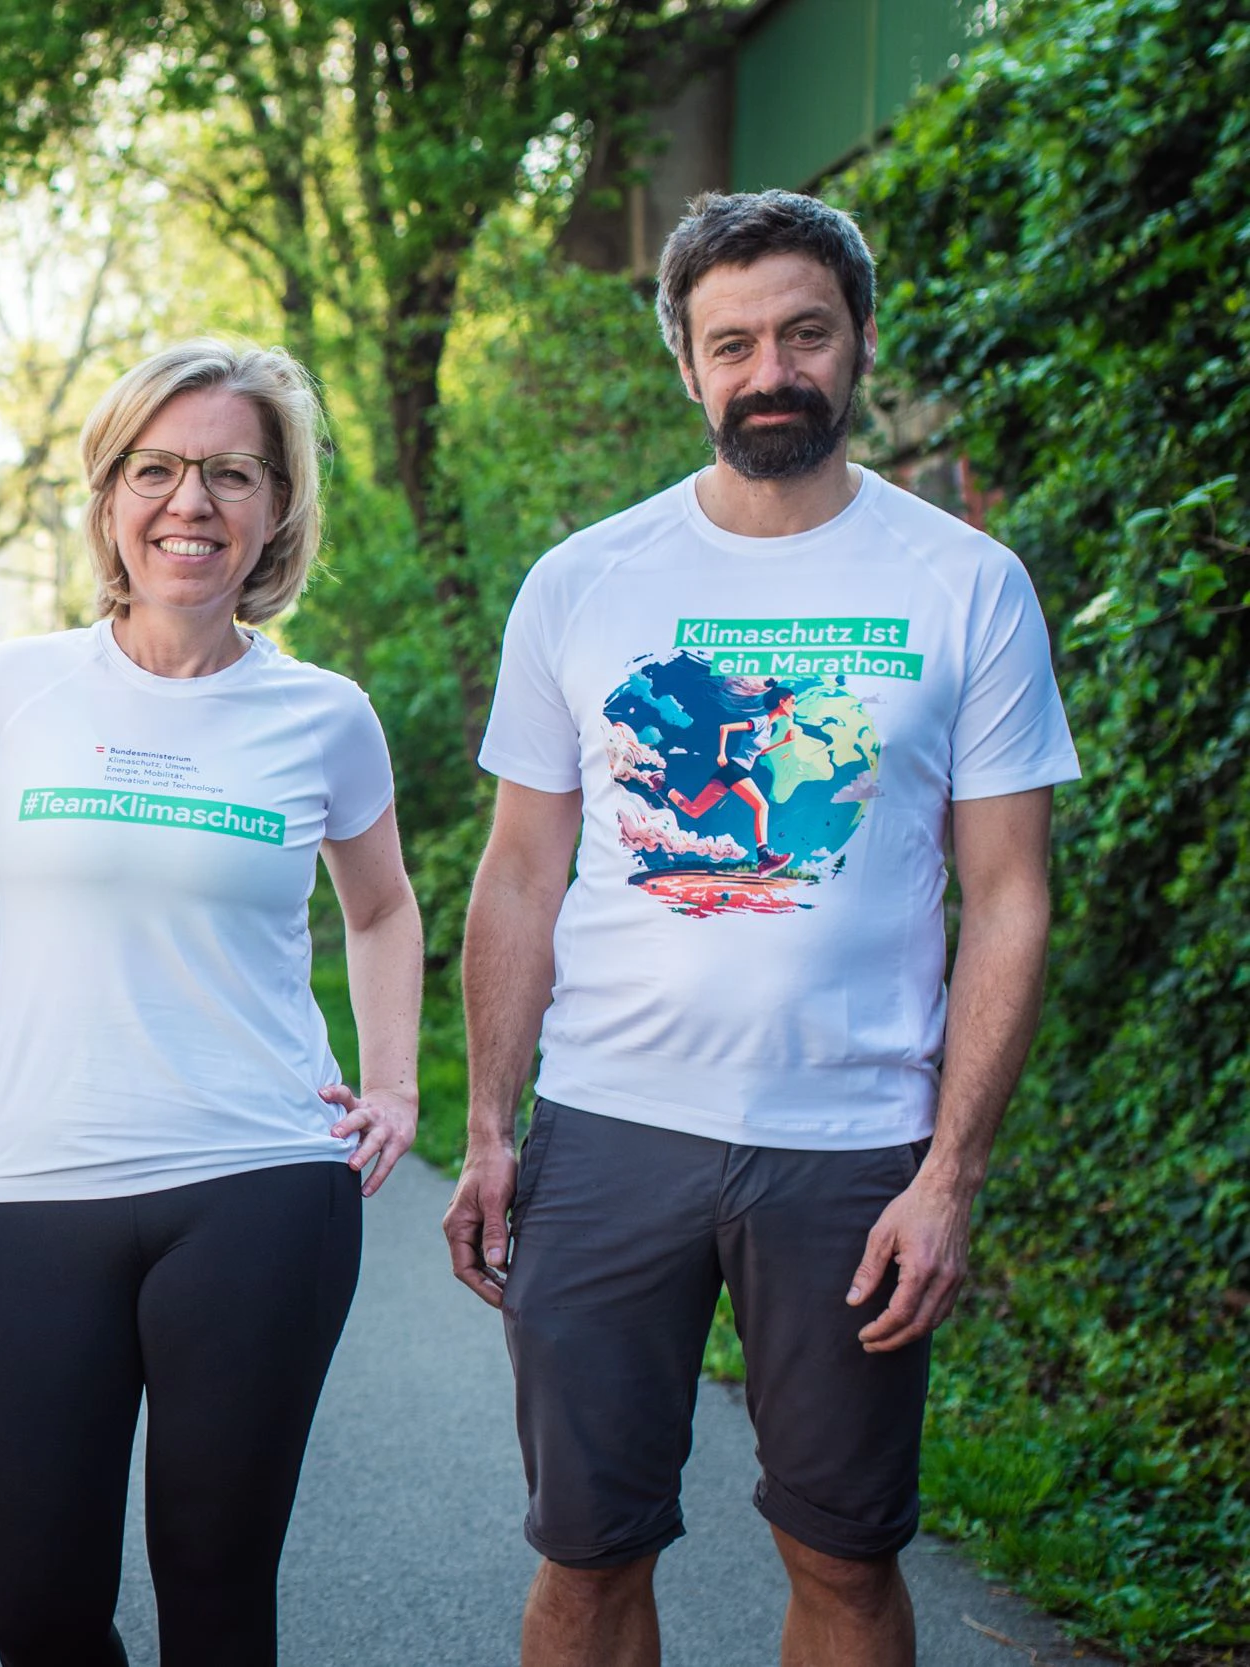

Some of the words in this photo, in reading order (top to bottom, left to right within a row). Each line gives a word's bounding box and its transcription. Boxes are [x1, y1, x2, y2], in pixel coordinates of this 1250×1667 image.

[682, 621, 853, 645] Klimaschutz
[863, 621, 900, 645] ist
[718, 653, 759, 674] ein
[770, 652, 914, 678] Marathon.
[110, 747, 191, 762] Bundesministerium
[106, 766, 141, 776] Energie,
[108, 757, 162, 769] Klimaschutz,
[165, 763, 200, 774] Umwelt,
[104, 775, 150, 785] Innovation
[152, 780, 169, 788] und
[172, 781, 224, 794] Technologie
[24, 791, 280, 839] #TeamKlimaschutz
